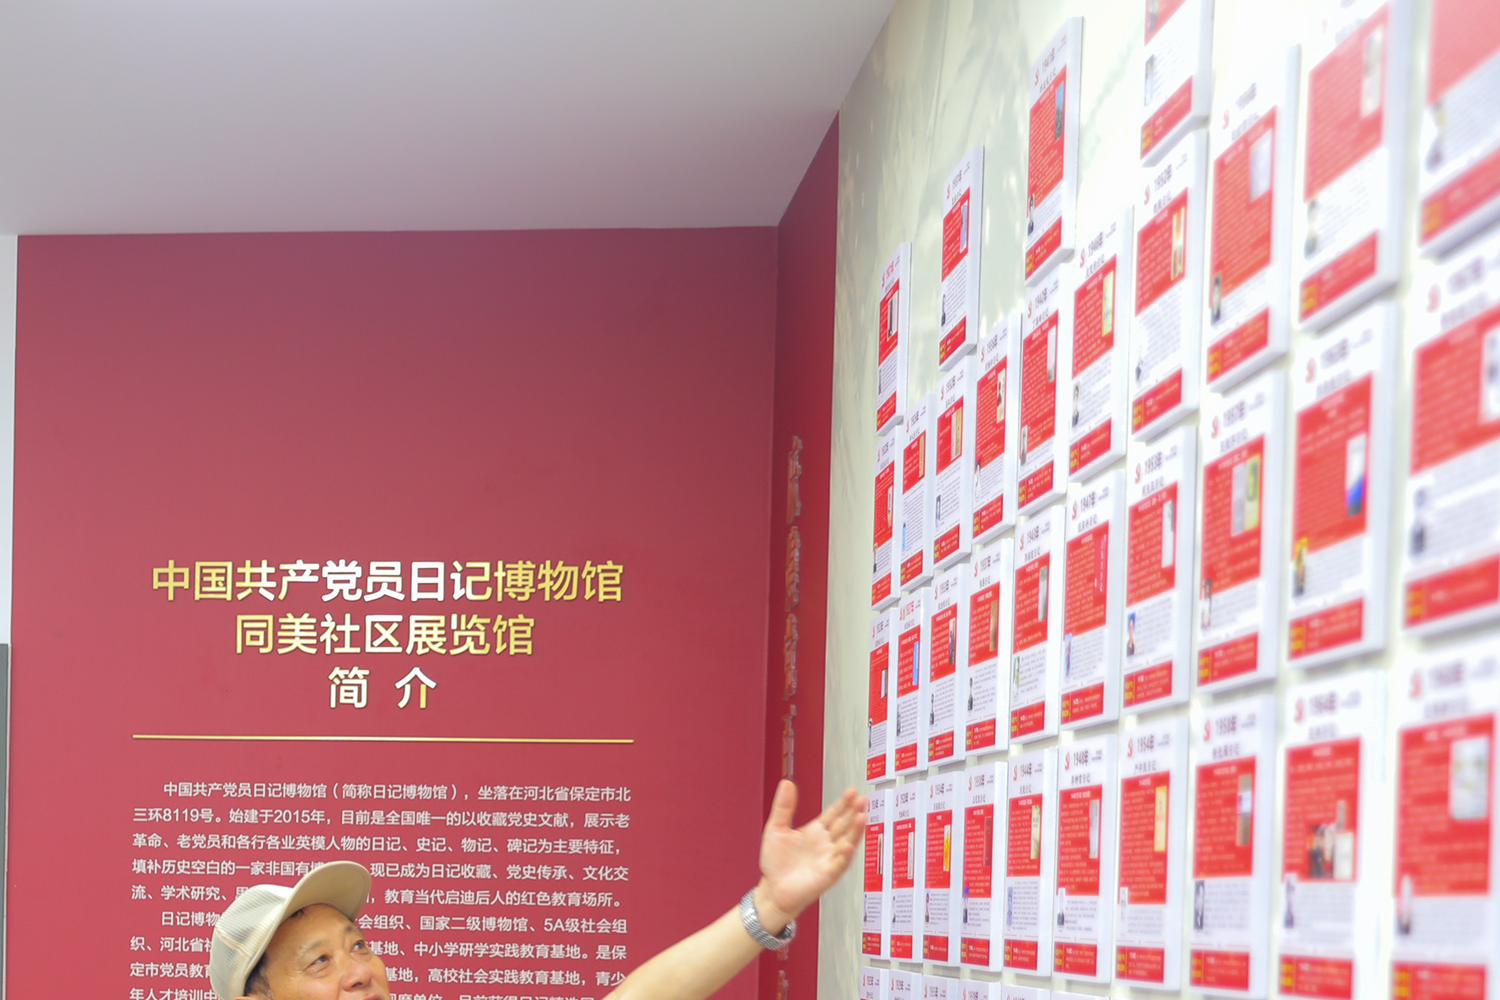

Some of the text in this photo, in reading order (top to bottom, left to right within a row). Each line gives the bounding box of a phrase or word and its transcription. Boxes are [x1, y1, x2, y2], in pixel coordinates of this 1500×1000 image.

[152, 560, 623, 602] 中国共产党员日记博物馆
[235, 613, 535, 655] 同美社区展览馆
[328, 666, 437, 708] 简 介
[1137, 735, 1155, 752] 1954年
[163, 782, 631, 802] 中国共产党员日记博物馆（简称日记博物馆），坐落在河北省保定市北
[133, 808, 630, 828] 三环8119号。始建于2015年，目前是全国唯一的以收藏党史文献，展示老
[132, 833, 620, 855] 革命、老党员和各行各业英模人物的日记、史记、物记、碑记为主要特征，
